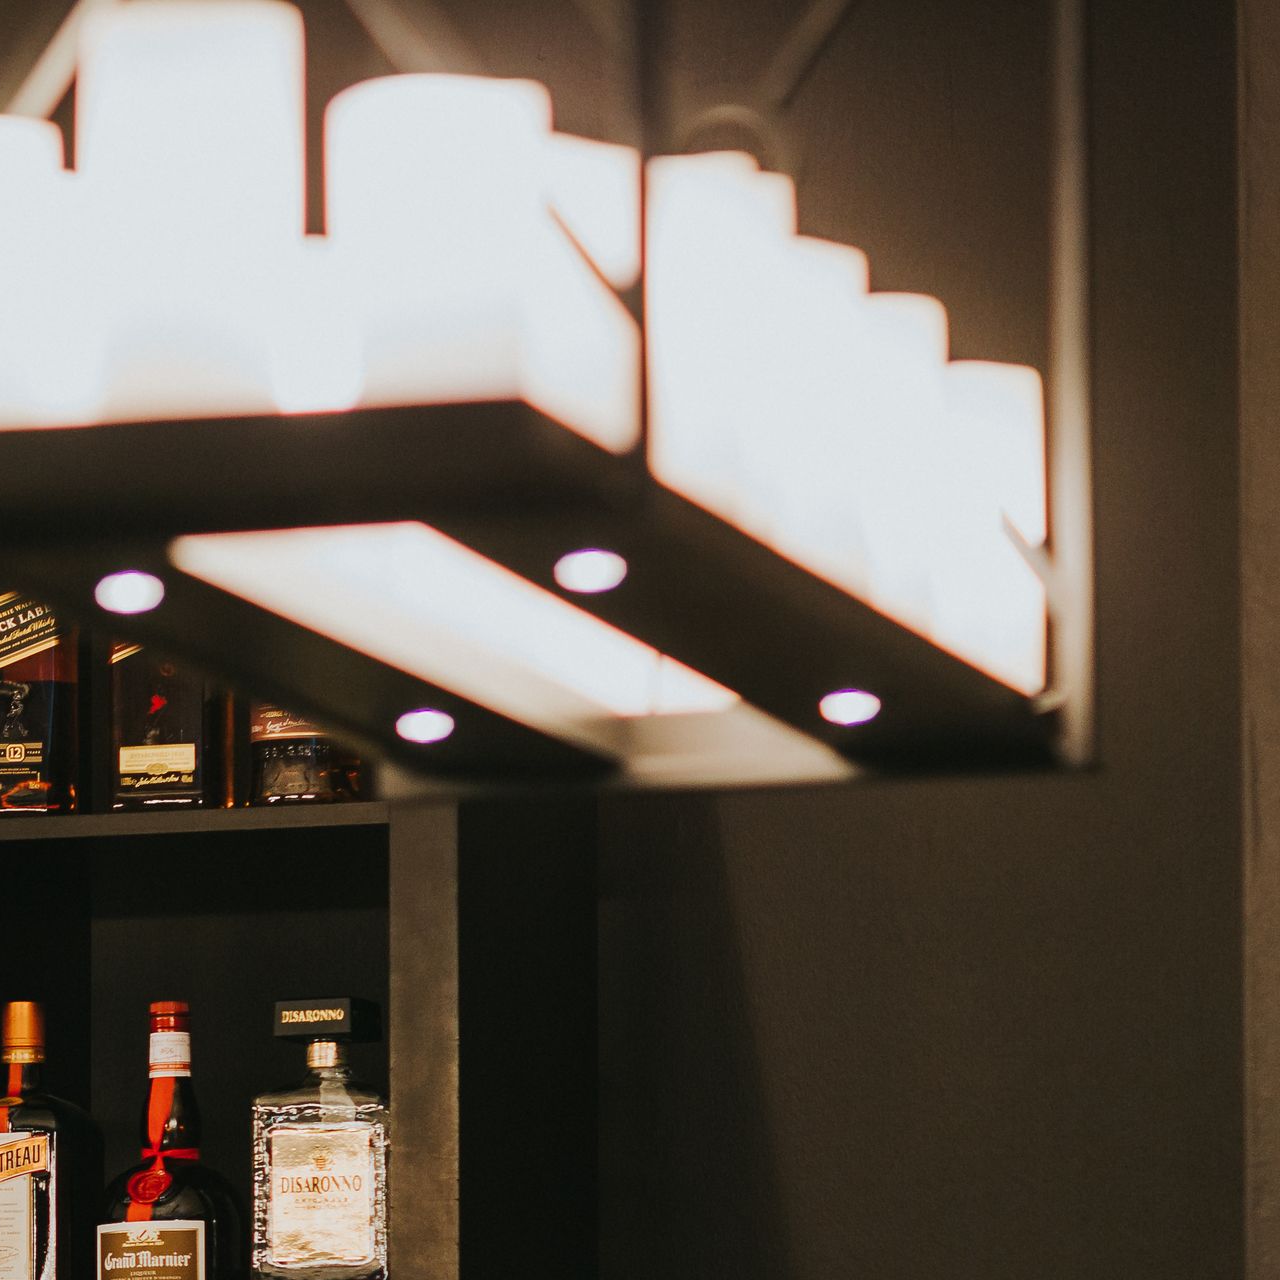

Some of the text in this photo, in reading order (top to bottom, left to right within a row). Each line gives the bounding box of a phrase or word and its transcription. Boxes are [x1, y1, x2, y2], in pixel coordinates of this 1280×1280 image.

[10, 748, 20, 758] 12
[281, 1008, 344, 1023] DISARONNO
[281, 1175, 362, 1194] DISARONNO
[104, 1251, 191, 1270] Grand Marnier
